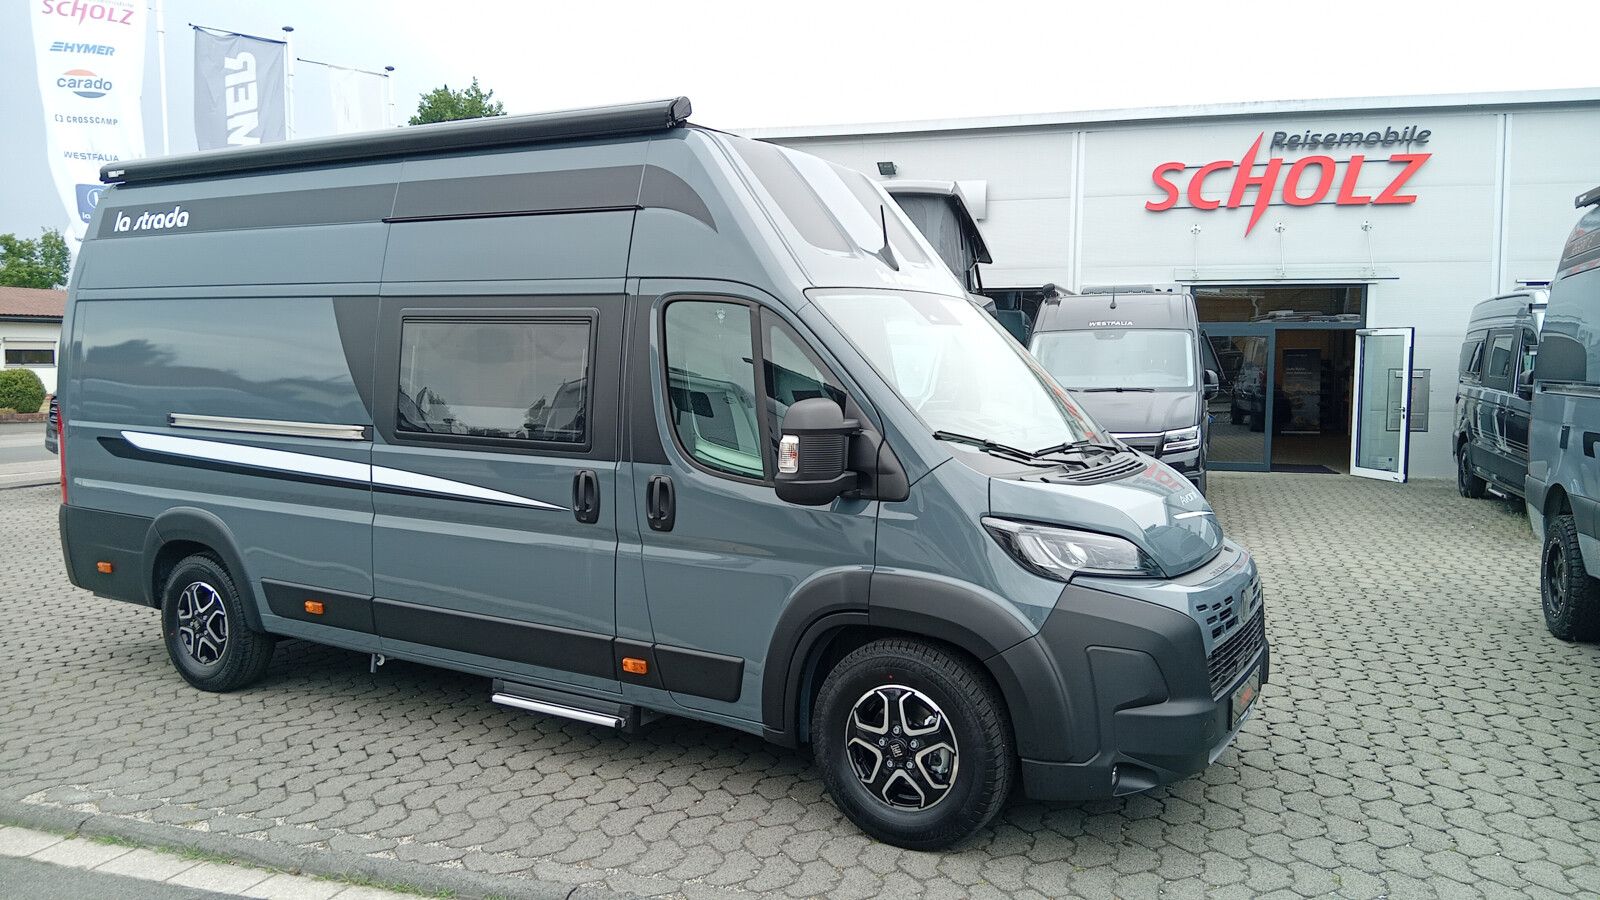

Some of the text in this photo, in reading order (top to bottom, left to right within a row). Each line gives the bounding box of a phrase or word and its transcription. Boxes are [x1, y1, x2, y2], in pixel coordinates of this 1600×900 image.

[42, 0, 134, 26] SCHOLZ
[63, 42, 116, 56] HYMER
[56, 77, 113, 91] carado
[66, 115, 119, 126] CROSSCAMP
[1269, 125, 1432, 151] Reisemobile
[63, 151, 120, 162] WESTFALIA
[1144, 131, 1433, 238] SCHOLZ
[114, 205, 190, 232] la strada
[1088, 320, 1134, 328] WESTFALIA
